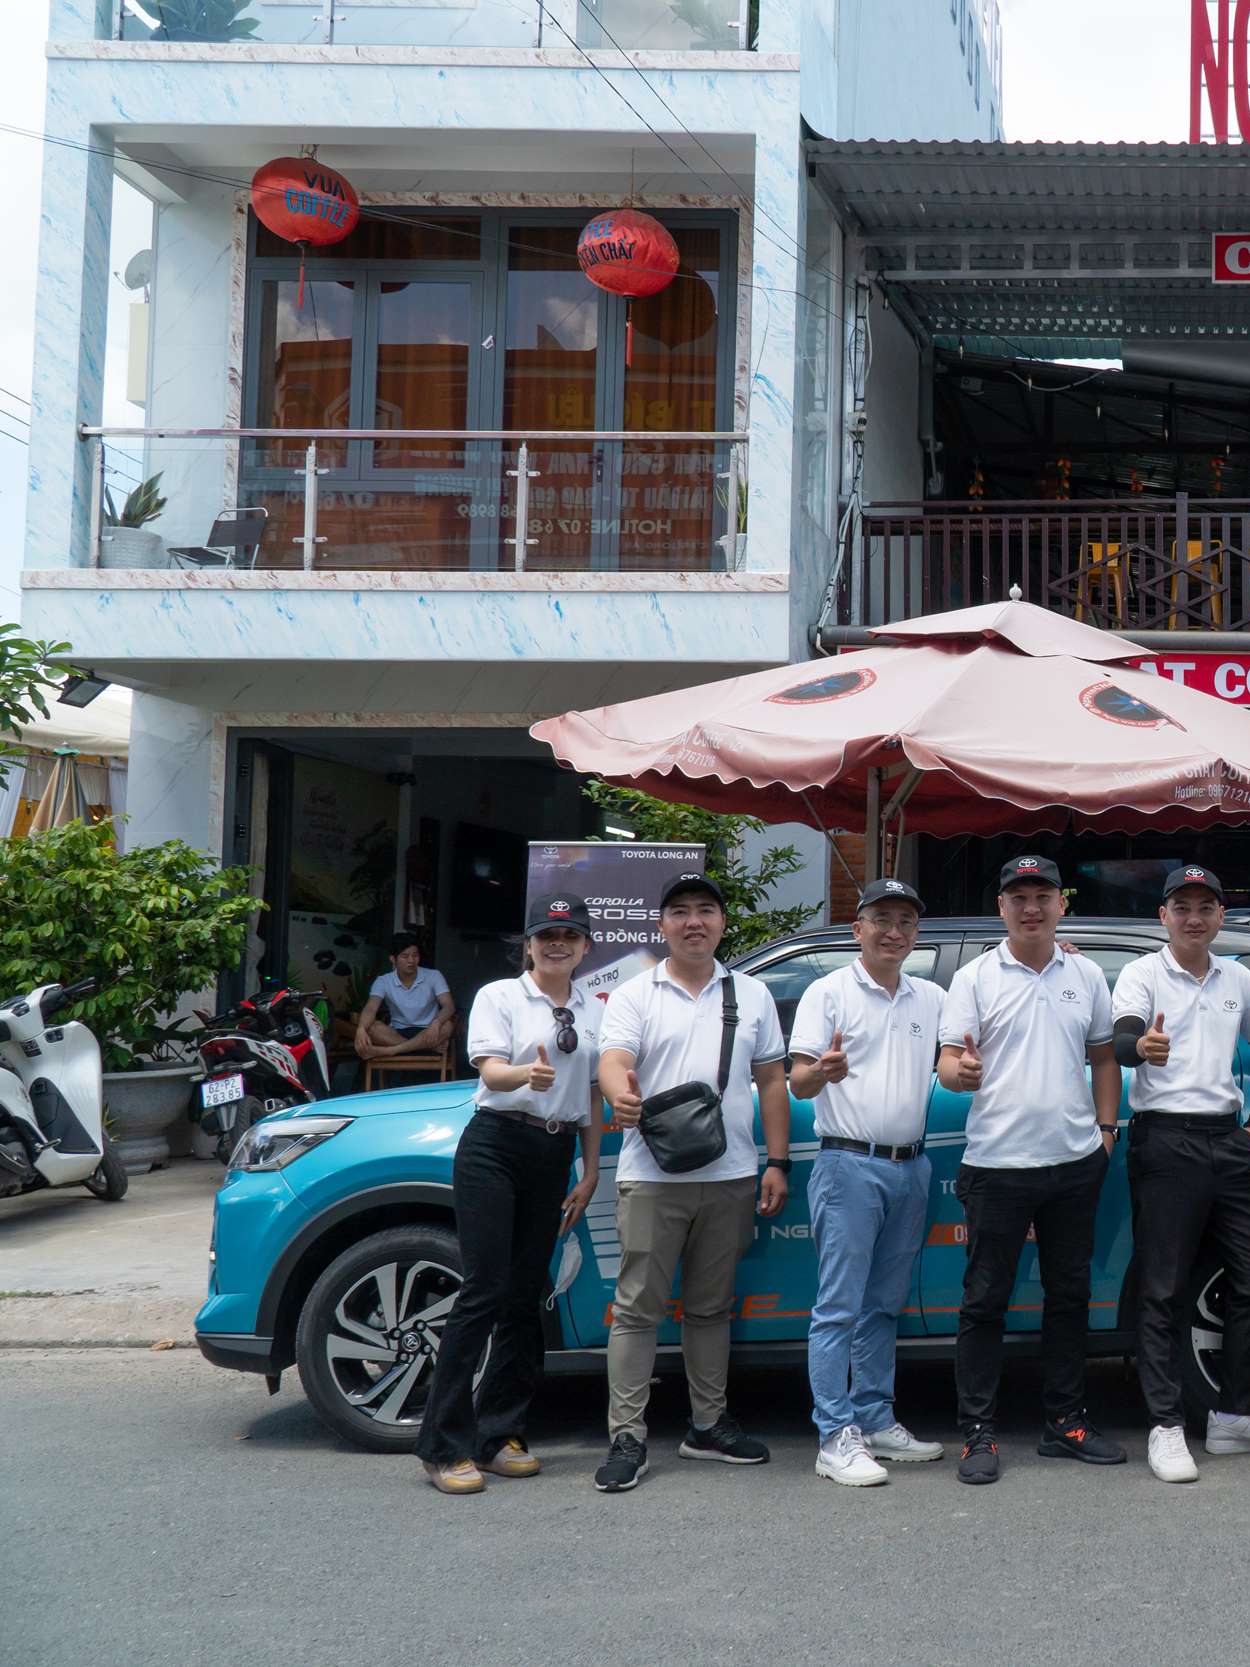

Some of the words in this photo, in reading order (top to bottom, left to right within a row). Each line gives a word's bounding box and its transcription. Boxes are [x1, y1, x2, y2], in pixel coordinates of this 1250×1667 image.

[303, 169, 346, 201] VUA
[285, 187, 350, 228] COFFEE
[621, 850, 656, 859] TOYOTA
[657, 851, 683, 860] LONG
[684, 851, 698, 860] AN
[584, 897, 645, 906] COROLLA
[606, 927, 648, 944] ĐỒNG
